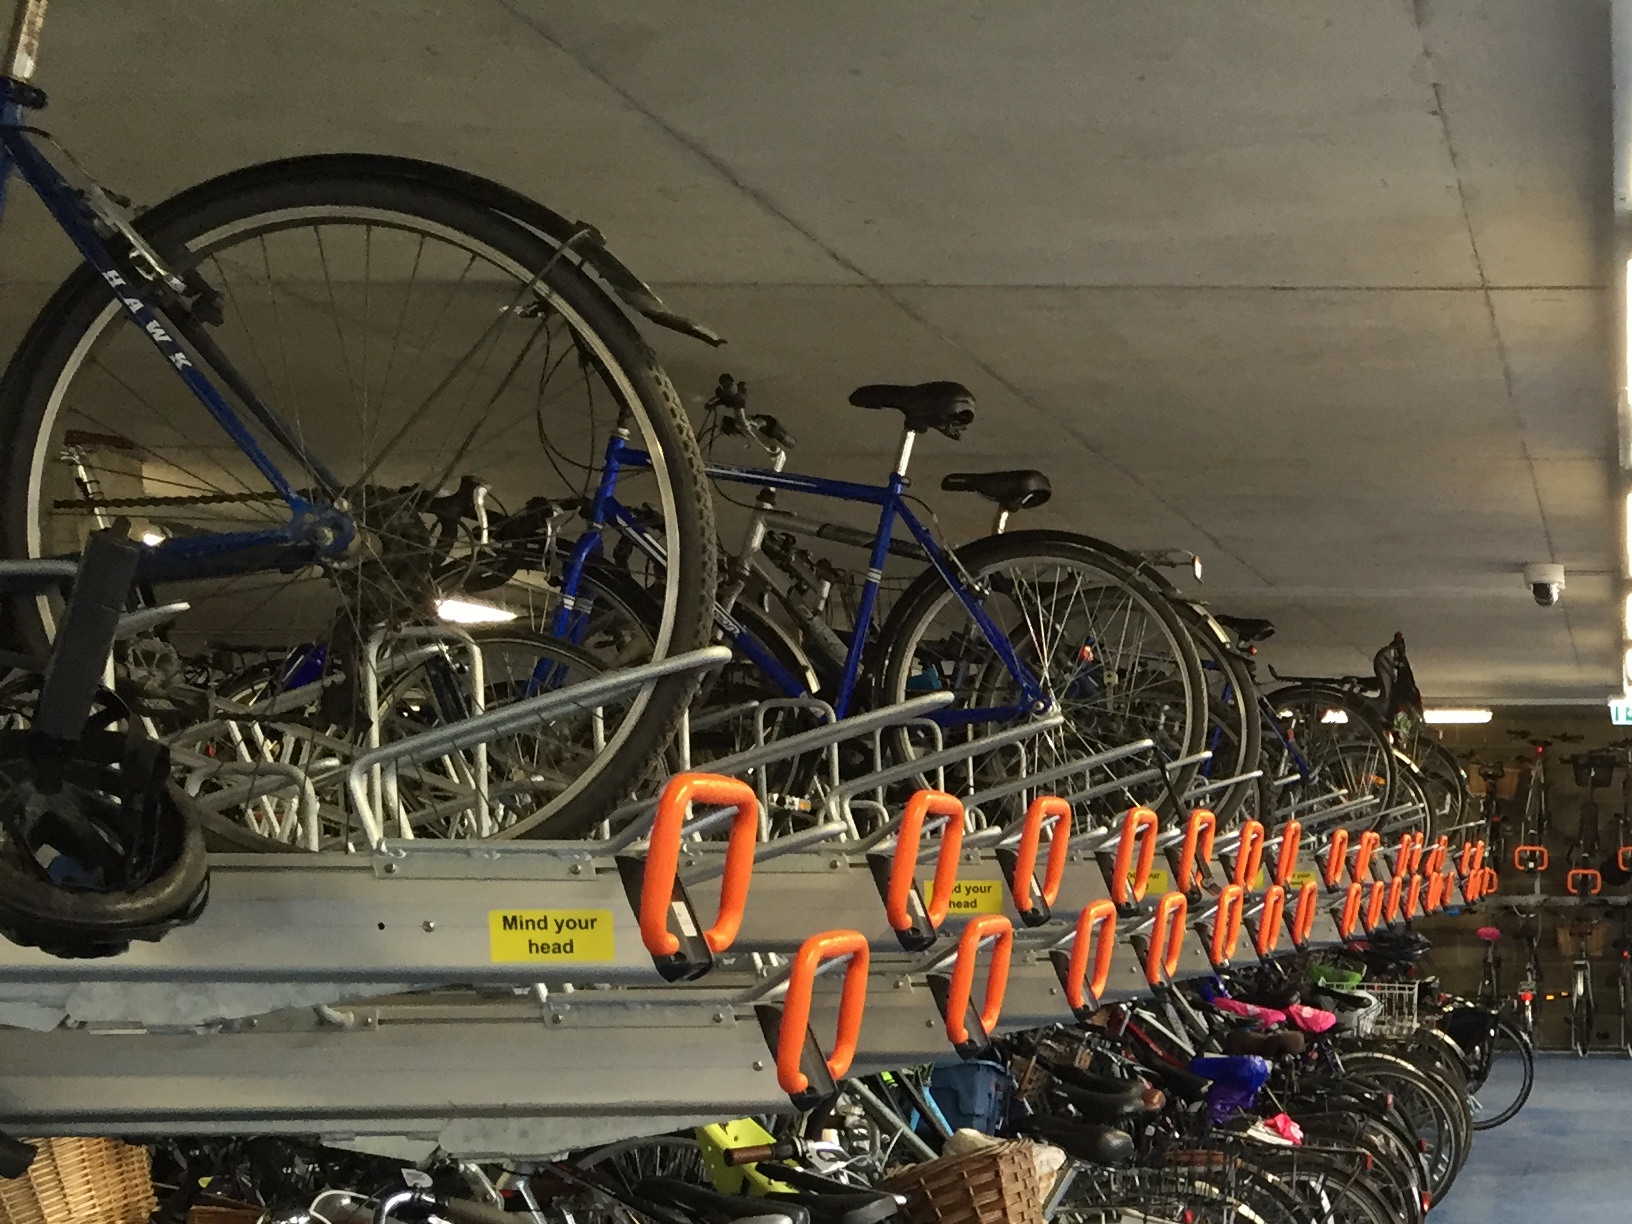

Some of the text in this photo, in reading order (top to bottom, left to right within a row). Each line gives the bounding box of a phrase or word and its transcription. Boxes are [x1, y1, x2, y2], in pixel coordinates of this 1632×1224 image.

[102, 269, 192, 370] HAWK
[965, 884, 992, 896] your
[502, 915, 597, 934] Mind your
[528, 939, 574, 954] head
